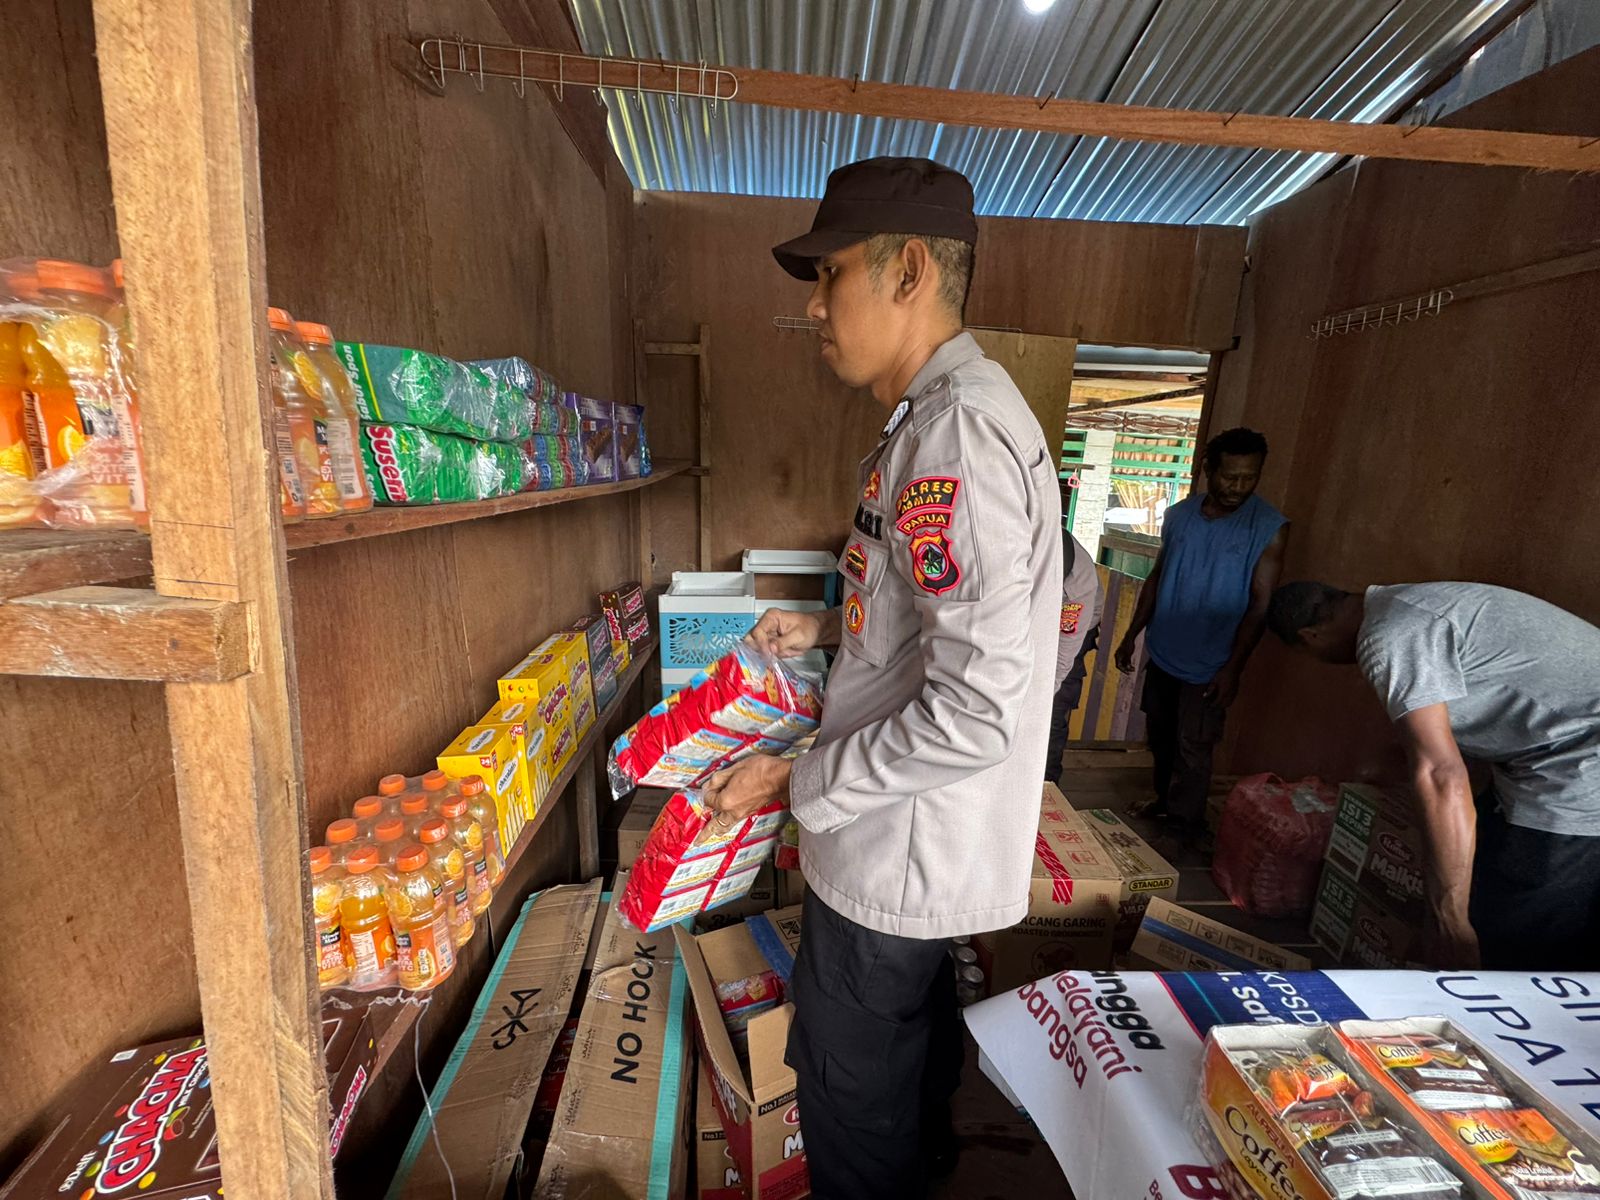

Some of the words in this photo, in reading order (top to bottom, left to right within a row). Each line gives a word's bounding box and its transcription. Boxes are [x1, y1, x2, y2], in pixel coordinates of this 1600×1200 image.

[903, 514, 947, 531] PAPUA
[1343, 800, 1361, 819] ISI
[1363, 813, 1373, 826] 3
[1132, 880, 1170, 890] STANDAR
[1063, 917, 1106, 930] GARING
[611, 1032, 643, 1084] NO
[1379, 1045, 1421, 1060] Coffee
[760, 1101, 778, 1114] No.1
[97, 1045, 209, 1194] CHACHA
[1458, 1122, 1510, 1145] Coffee
[1224, 1105, 1304, 1200] Coffe
[1239, 1147, 1268, 1182] Layer
